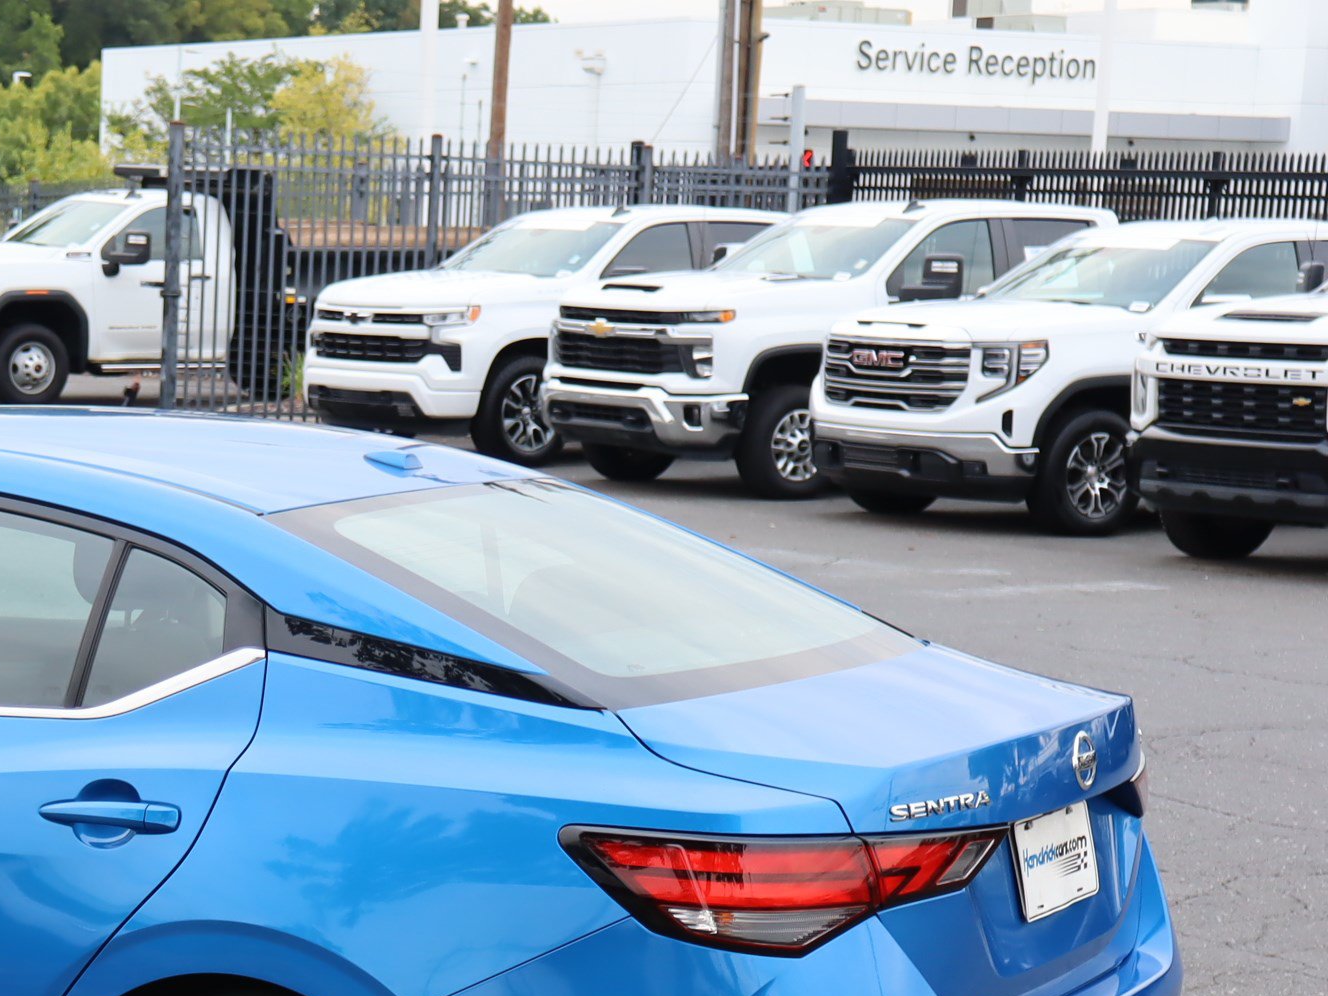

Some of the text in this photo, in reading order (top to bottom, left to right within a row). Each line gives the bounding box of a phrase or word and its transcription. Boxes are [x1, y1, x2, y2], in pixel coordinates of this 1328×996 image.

[856, 40, 1096, 84] Service Reception
[852, 348, 905, 367] GMC
[1155, 361, 1324, 380] CHEVROLET
[889, 790, 990, 822] SENTRA
